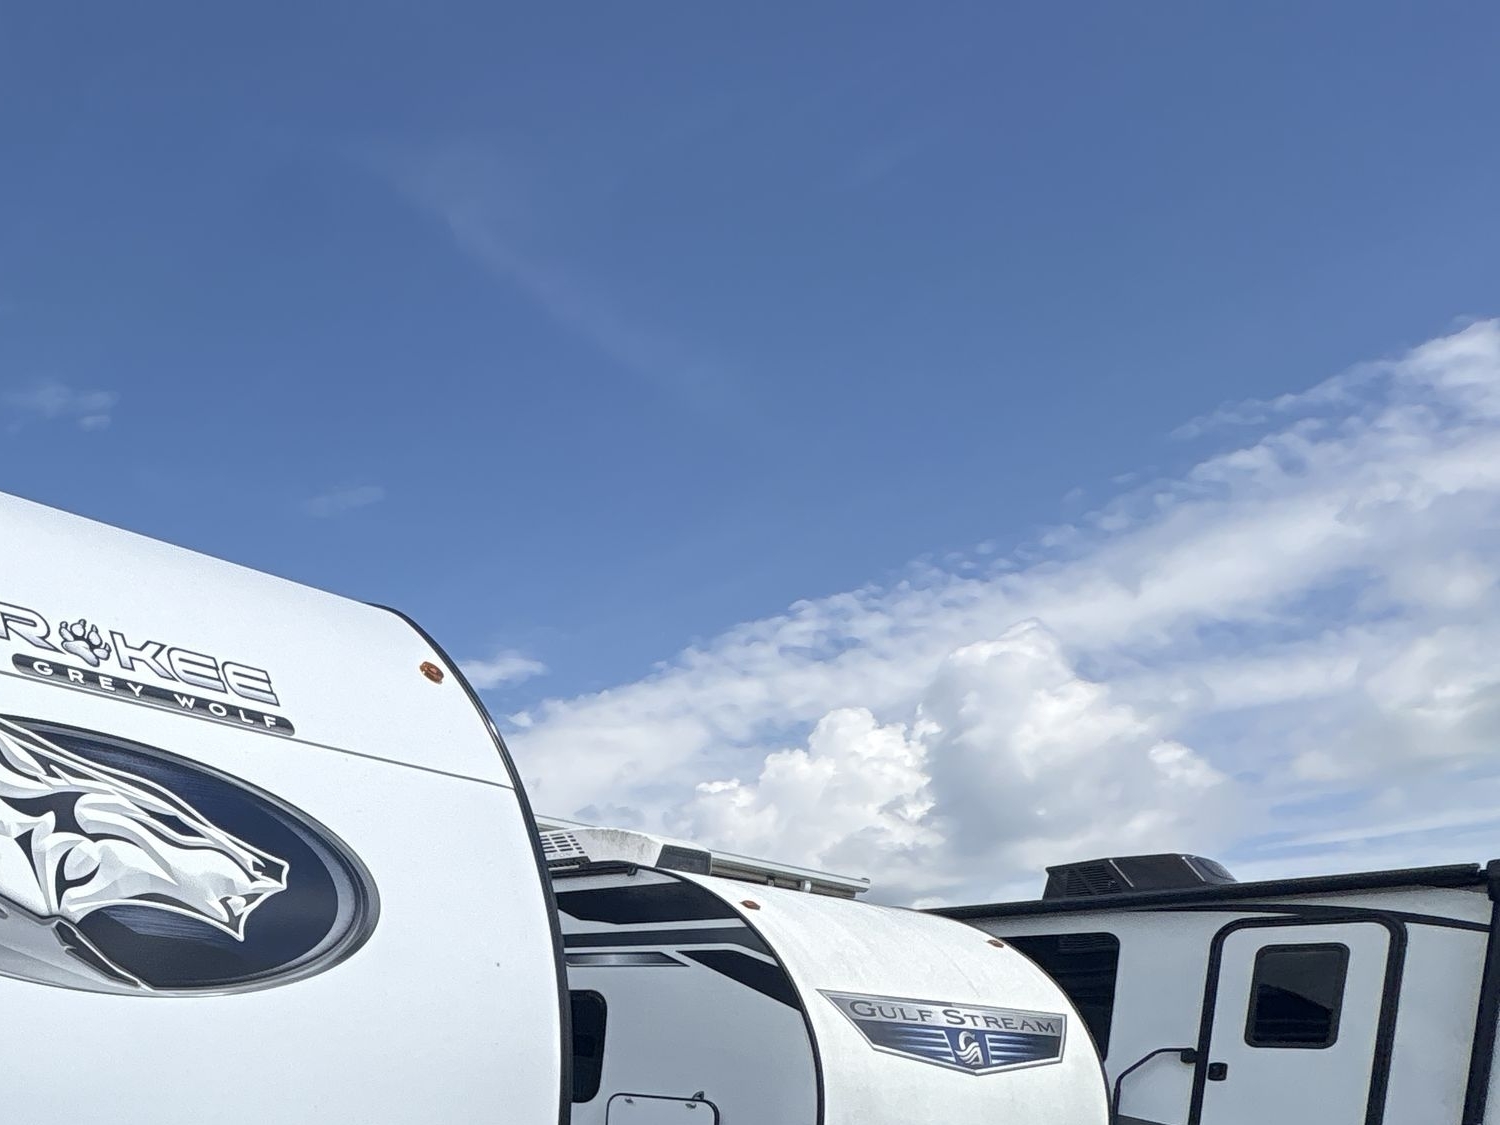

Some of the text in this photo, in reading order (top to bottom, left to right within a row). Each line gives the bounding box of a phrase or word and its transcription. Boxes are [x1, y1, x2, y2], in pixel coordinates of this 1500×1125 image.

[31, 660, 279, 729] GREY WOLF
[850, 1001, 1056, 1034] GULF STREAM
